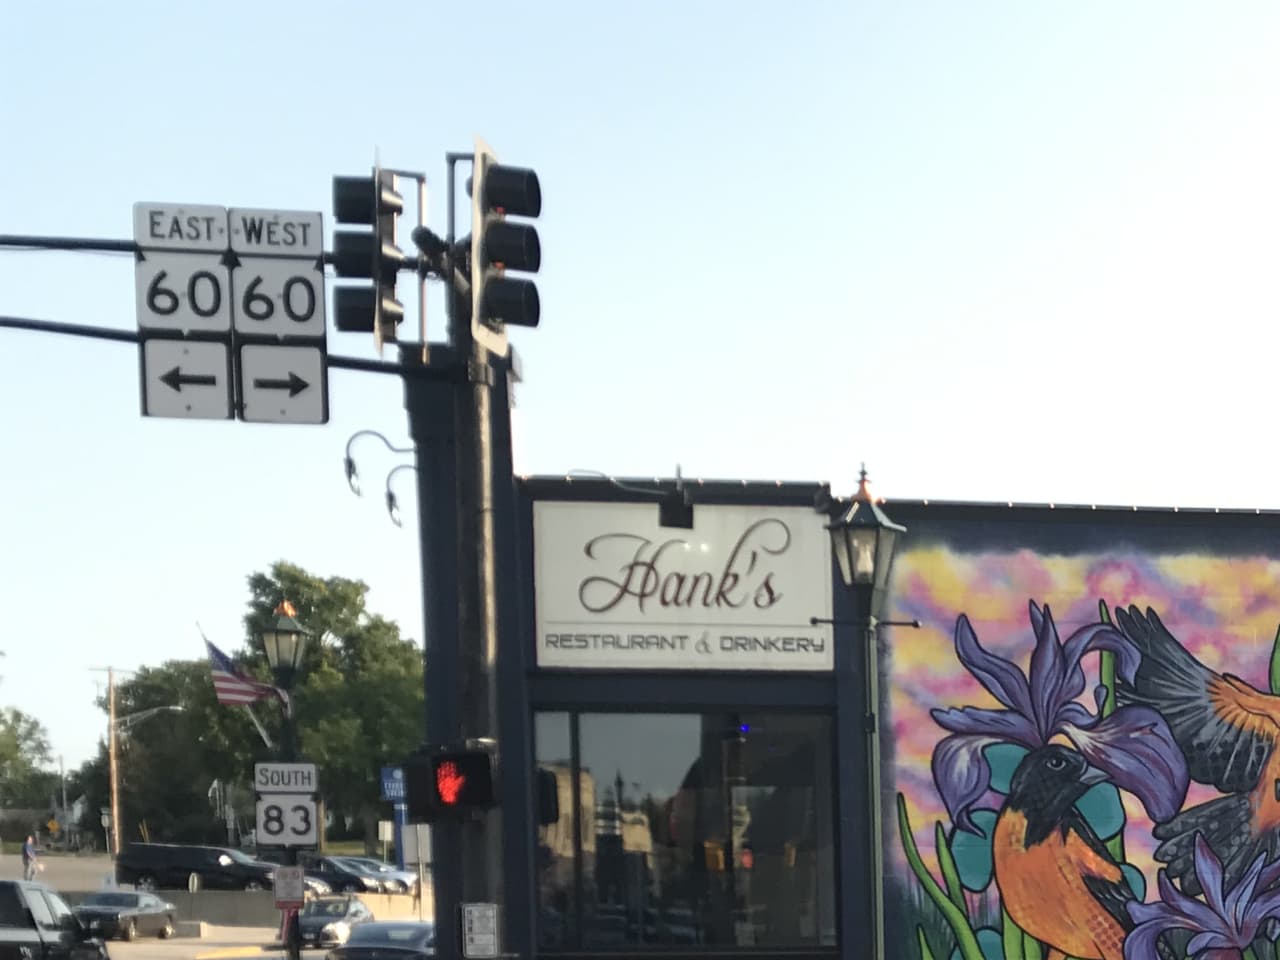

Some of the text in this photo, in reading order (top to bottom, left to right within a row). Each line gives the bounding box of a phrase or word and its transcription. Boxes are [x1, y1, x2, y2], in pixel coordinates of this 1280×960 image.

[149, 210, 215, 241] EAST
[241, 216, 311, 247] WEST
[146, 269, 221, 317] 60
[242, 275, 316, 323] 60
[578, 518, 791, 615] Hank's
[545, 633, 689, 650] RESTAURANT
[719, 635, 825, 653] DRINKERY
[258, 767, 312, 787] SOUTH
[263, 804, 311, 836] 83
